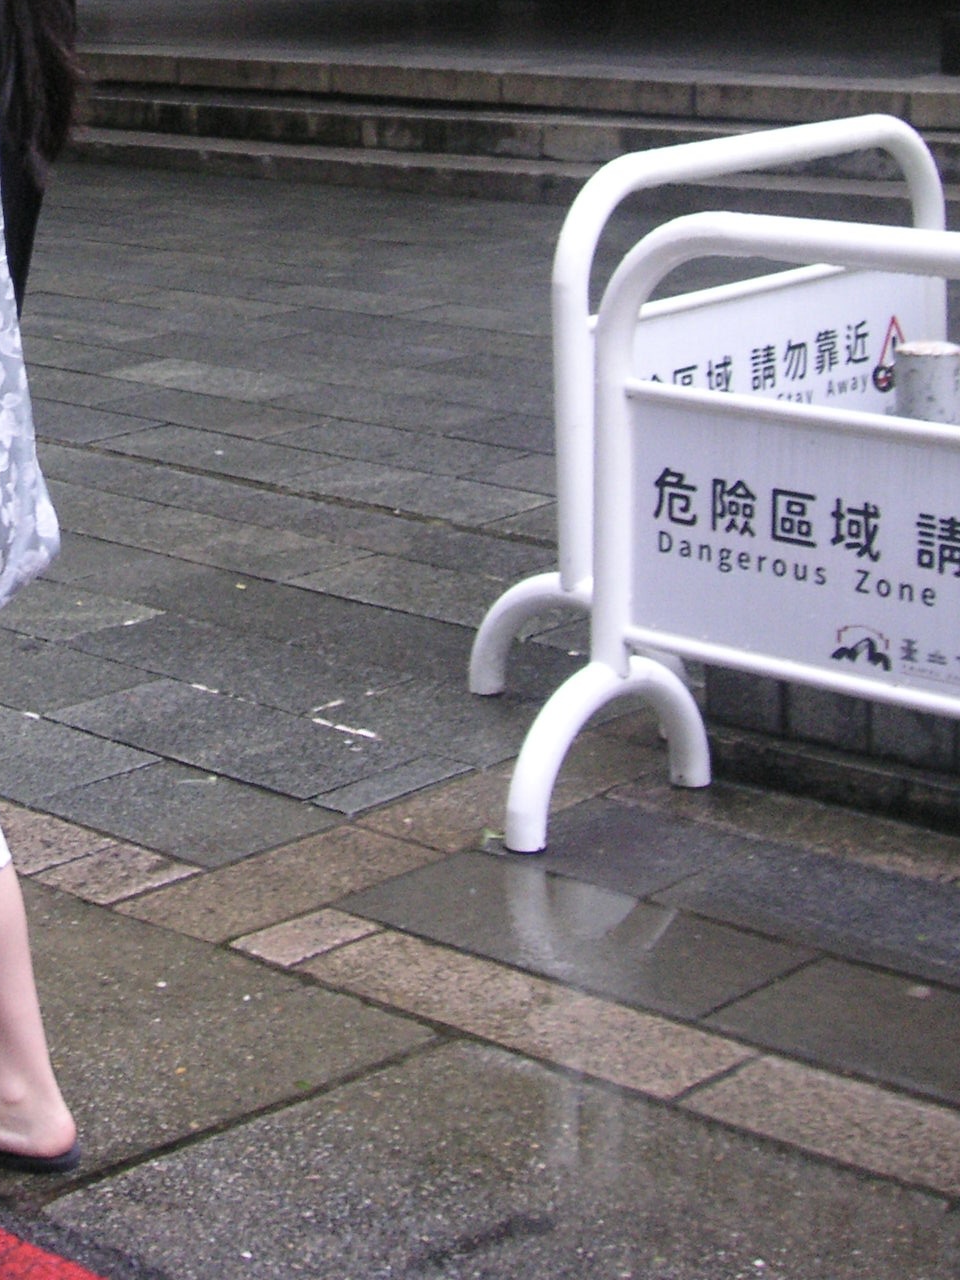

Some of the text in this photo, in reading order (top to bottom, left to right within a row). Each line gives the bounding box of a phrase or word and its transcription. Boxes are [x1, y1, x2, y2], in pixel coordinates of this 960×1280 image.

[826, 371, 869, 397] Away
[653, 467, 881, 563] 危險區域
[657, 530, 937, 607] Dangerous Zone
